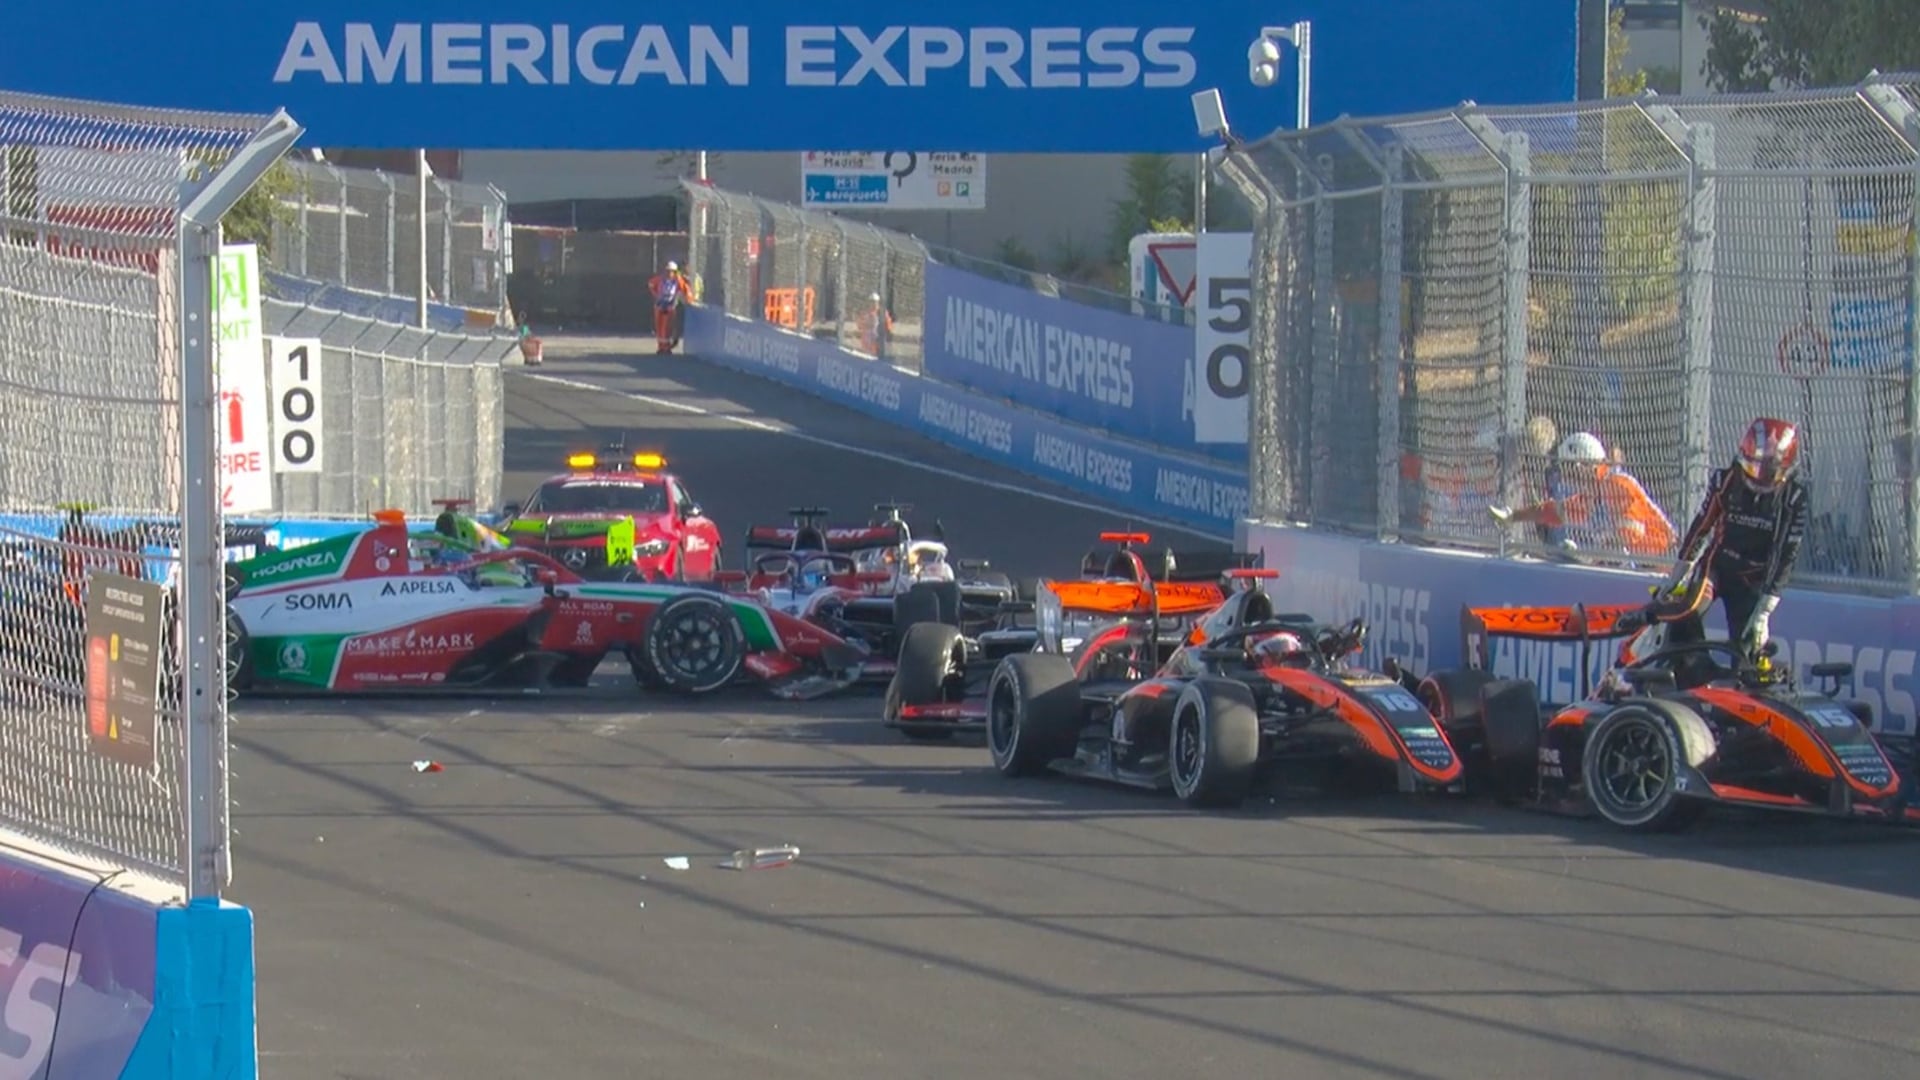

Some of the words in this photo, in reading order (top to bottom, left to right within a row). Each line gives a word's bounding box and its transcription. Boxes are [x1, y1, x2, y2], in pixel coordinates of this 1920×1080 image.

[274, 22, 748, 86] AMERICAN
[785, 26, 1197, 88] EXPRESS
[933, 165, 973, 175] Madrid
[824, 188, 888, 202] aeropuerto
[723, 326, 762, 361] AMERICAN
[763, 337, 800, 374] EXPRESS
[944, 296, 1041, 382] AMERICAN
[1045, 325, 1134, 409] EXPRESS
[816, 354, 861, 397] AMERICAN
[861, 371, 901, 411] EXPRESS
[918, 391, 966, 435] AMERICAN
[967, 410, 1013, 453] EXPRESS
[1033, 431, 1087, 477] AMERICAN
[1086, 451, 1133, 492] EXPRESS
[1154, 467, 1211, 516] AMERICAN
[251, 551, 336, 578] HOGANZA
[285, 593, 353, 611] SOMA
[400, 581, 455, 595] APELSA
[347, 637, 402, 652] MAKE
[419, 633, 475, 649] MARK
[1803, 709, 1855, 728] 15
